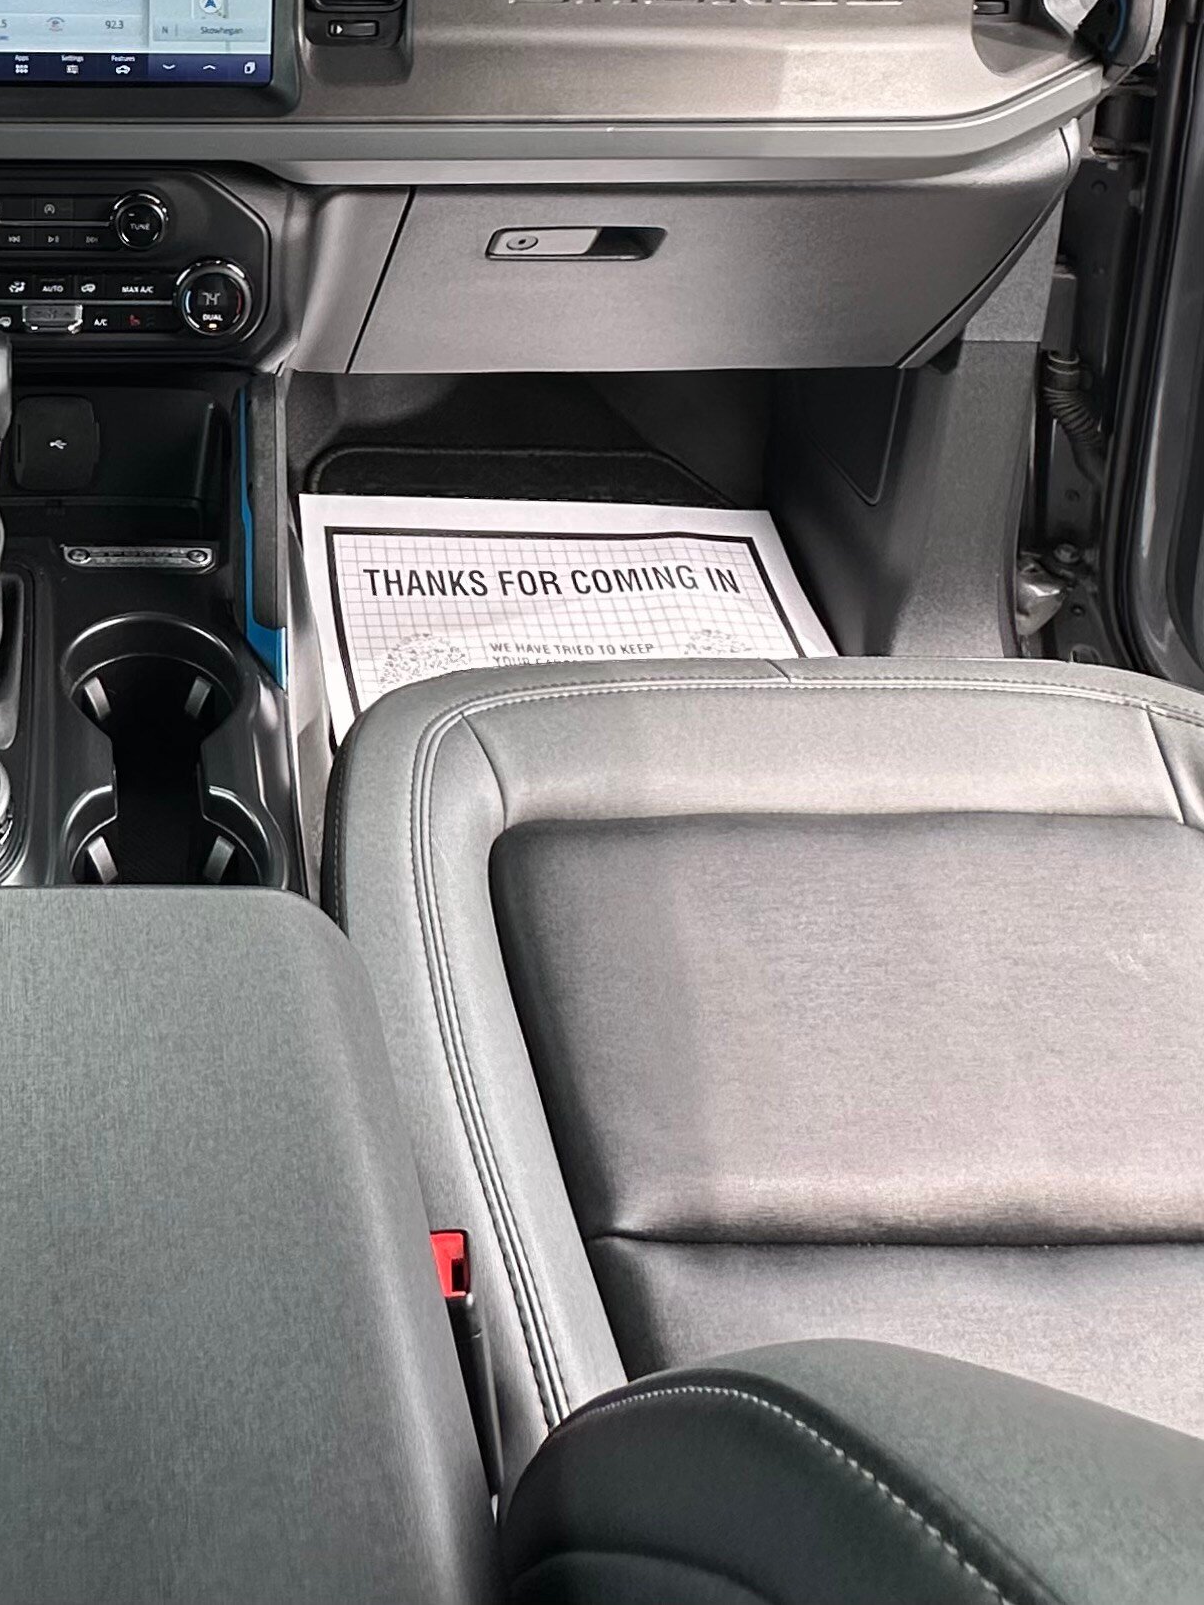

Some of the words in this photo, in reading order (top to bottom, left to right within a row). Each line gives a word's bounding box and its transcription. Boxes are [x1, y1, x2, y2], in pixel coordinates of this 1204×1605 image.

[200, 26, 244, 37] Skowhegan
[130, 223, 150, 231] TUNE
[42, 285, 64, 293] AUTO
[363, 568, 488, 596] THANKS
[500, 569, 563, 595] FOR
[571, 565, 699, 594] COMING
[705, 567, 741, 594] IN
[490, 643, 512, 652] WE
[516, 644, 550, 654] HAVE
[553, 645, 594, 655] TRIED
[598, 645, 616, 655] TO
[620, 643, 654, 654] KEEP
